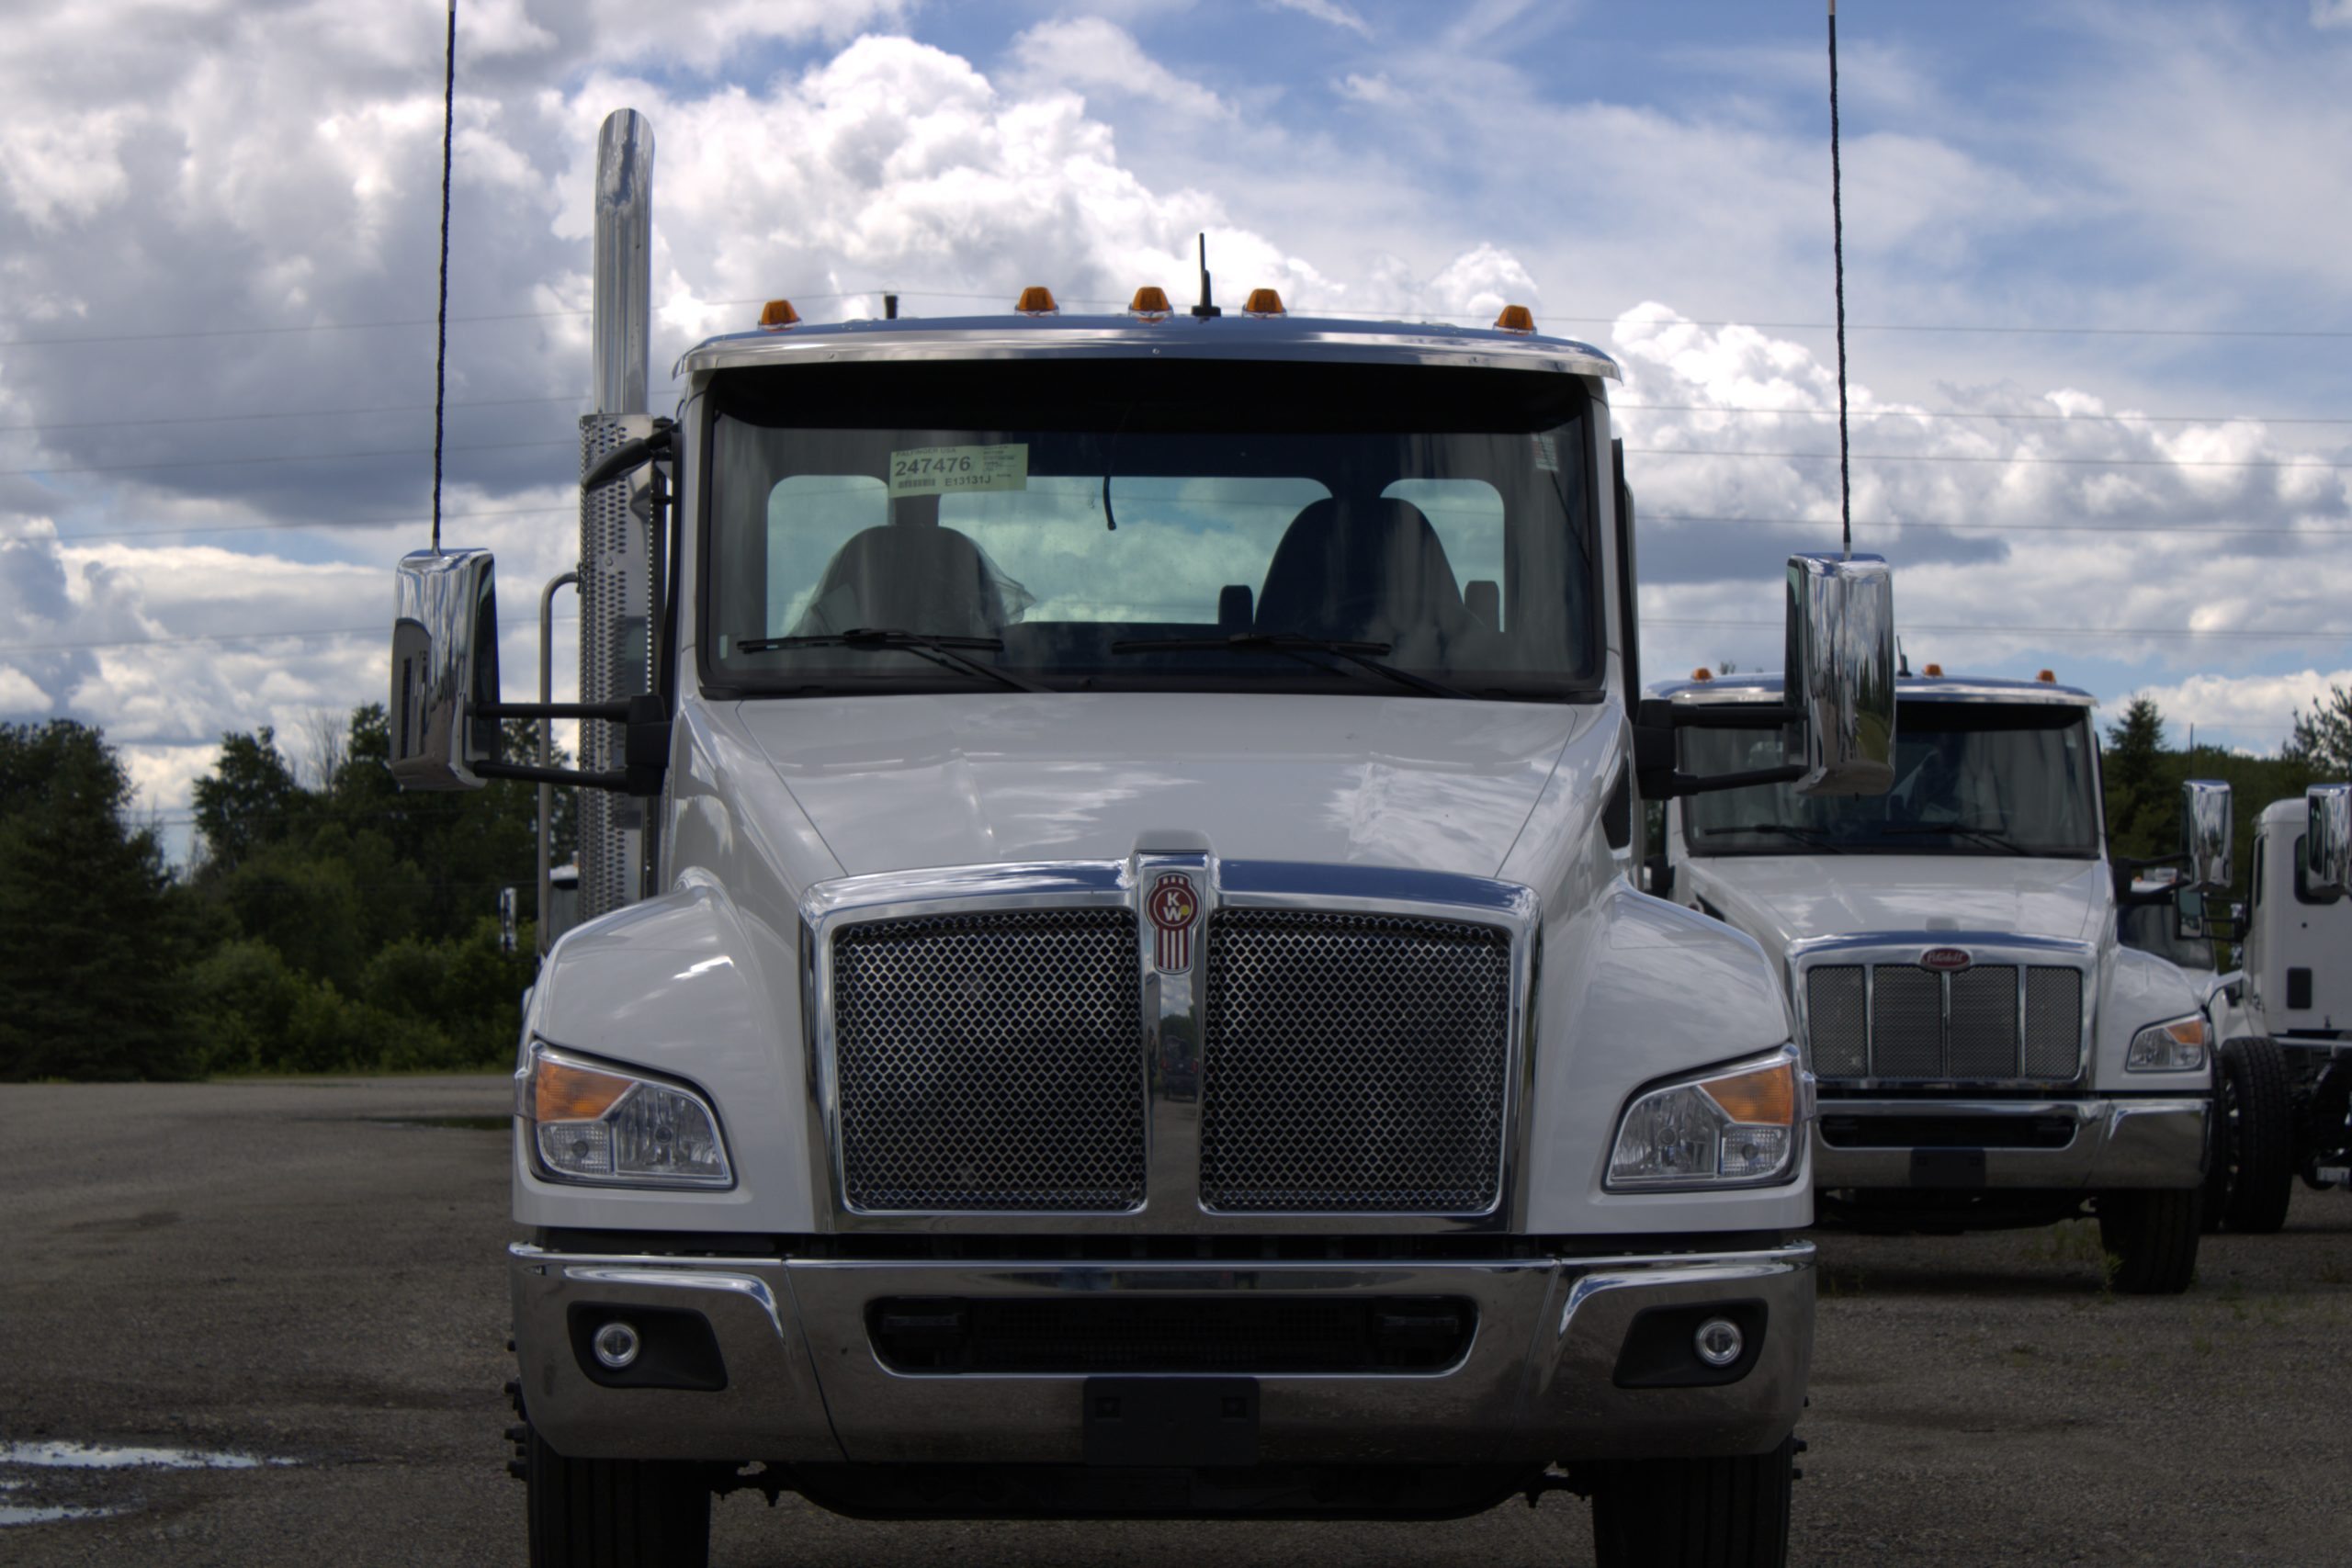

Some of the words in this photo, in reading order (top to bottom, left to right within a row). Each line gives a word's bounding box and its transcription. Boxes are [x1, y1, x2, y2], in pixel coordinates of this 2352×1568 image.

[896, 447, 938, 457] PALFINGER
[895, 456, 971, 477] 247476
[944, 475, 991, 487] E13131J
